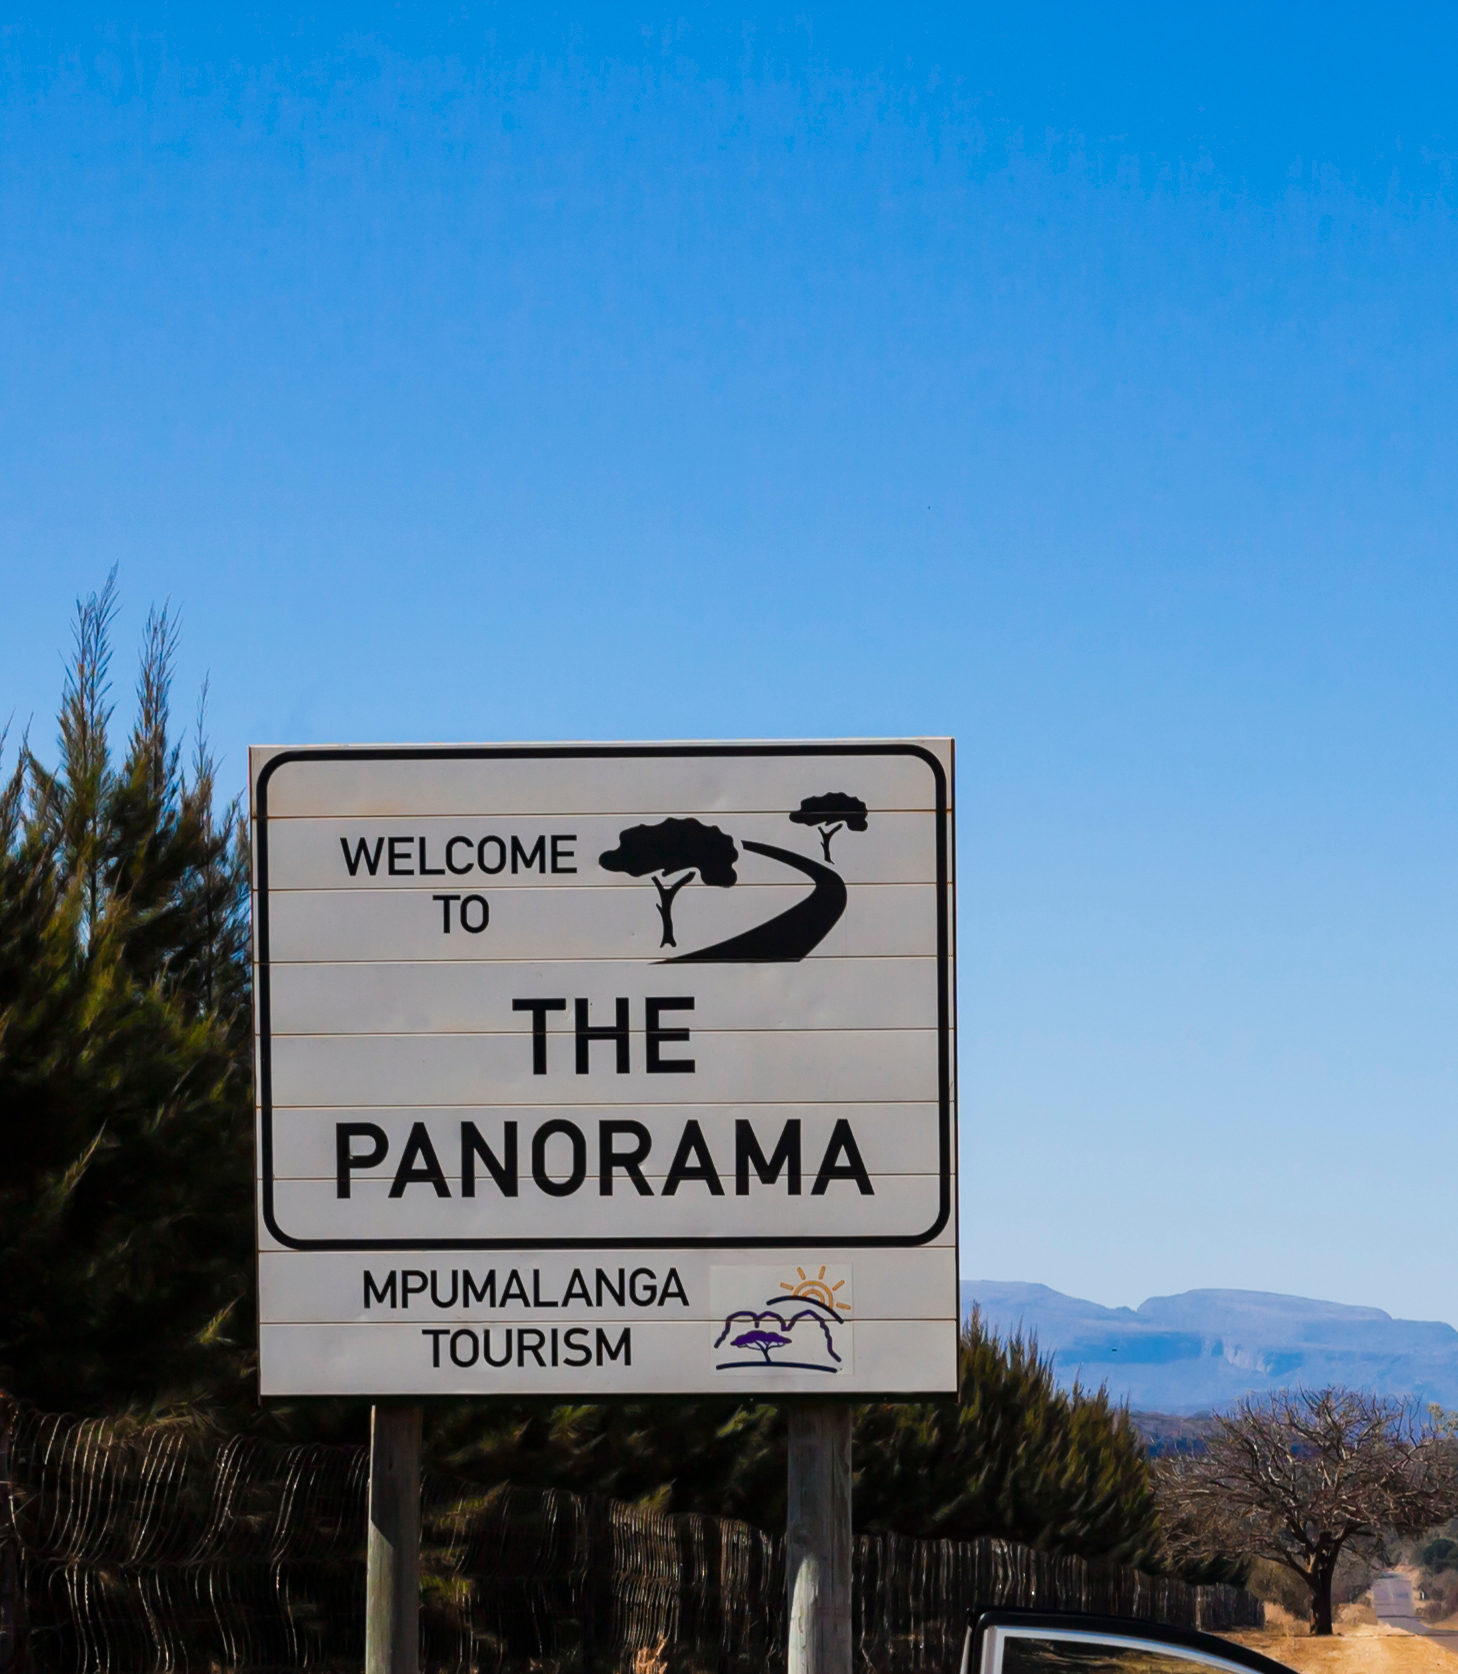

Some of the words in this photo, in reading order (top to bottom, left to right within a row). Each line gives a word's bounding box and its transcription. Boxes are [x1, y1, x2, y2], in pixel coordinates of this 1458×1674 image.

[340, 835, 577, 876] WELCOME
[433, 895, 489, 933] TO
[512, 996, 695, 1075] THE
[335, 1119, 875, 1199] PANORAMA
[363, 1268, 689, 1309] MPUMALANGA
[422, 1328, 632, 1368] TOURISM
